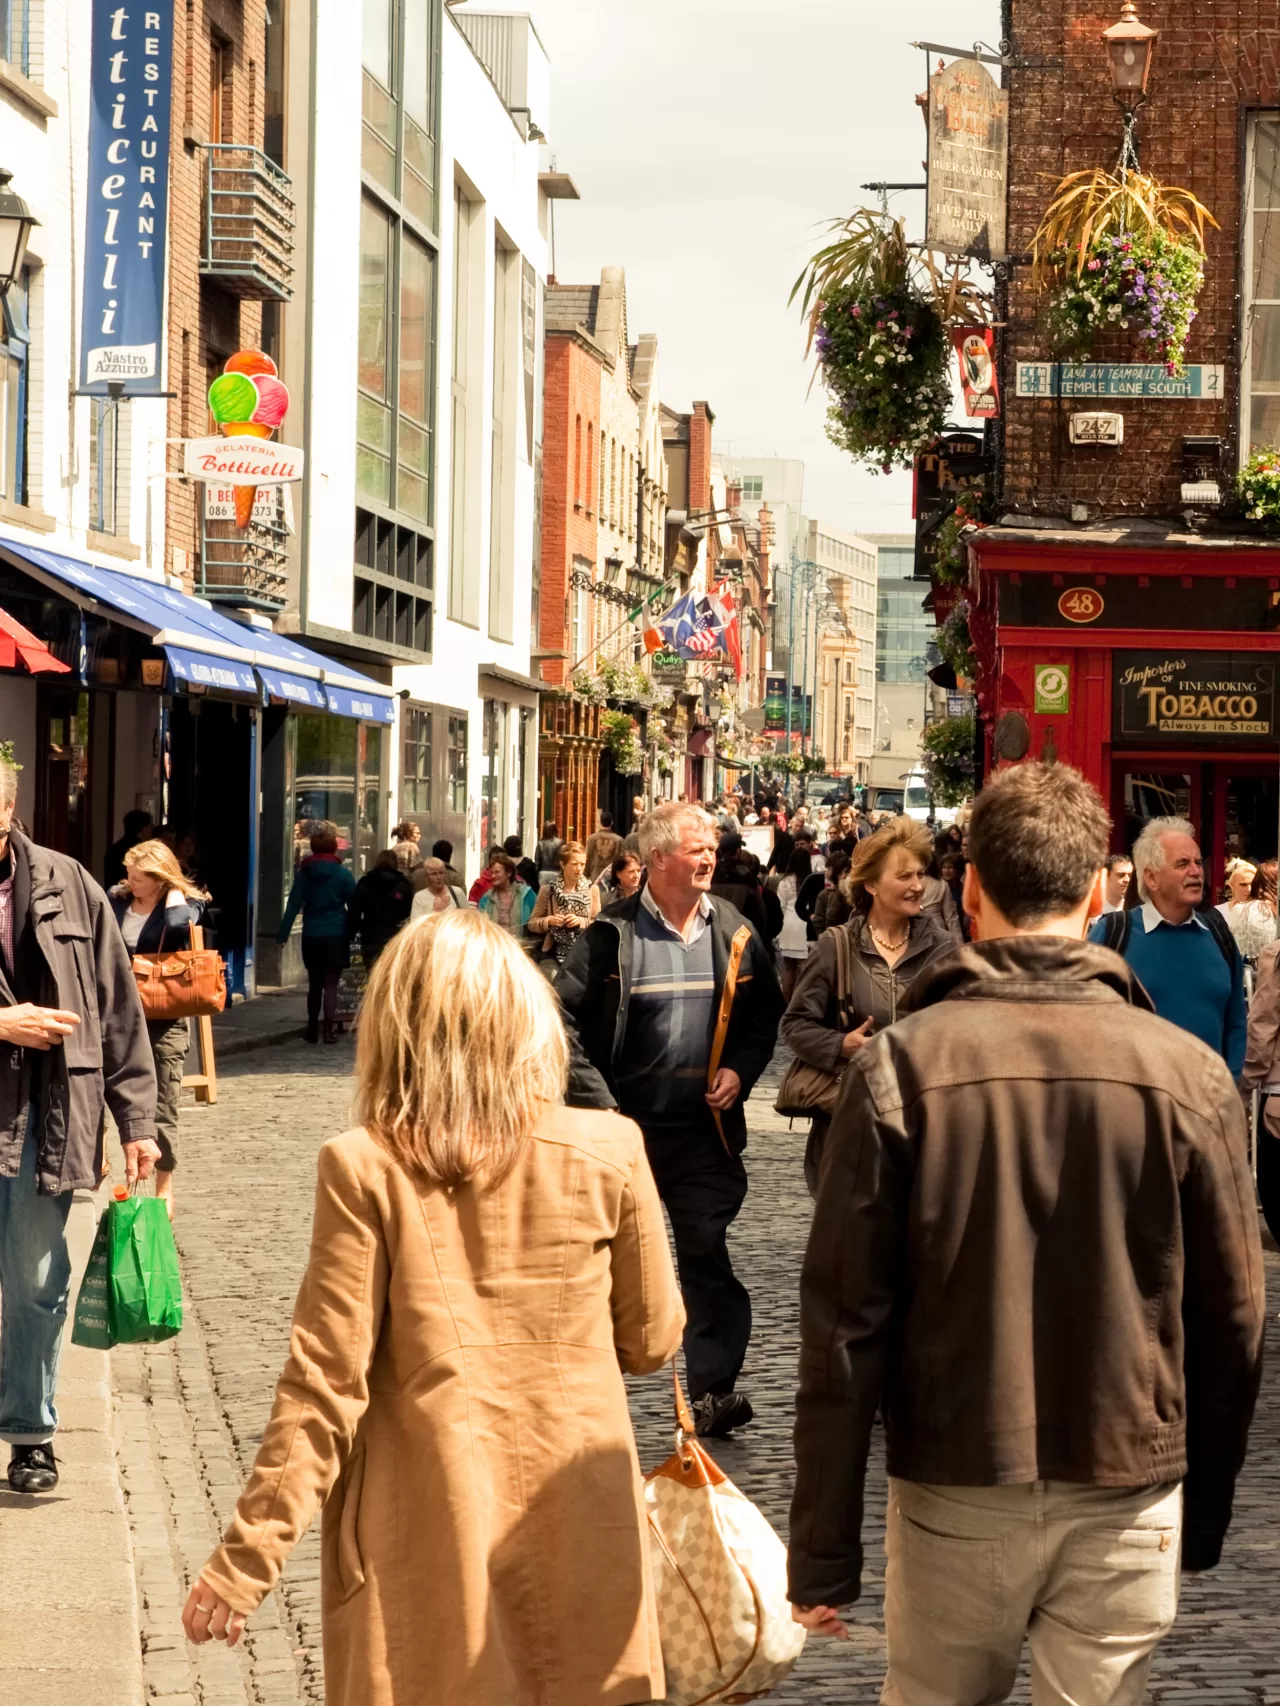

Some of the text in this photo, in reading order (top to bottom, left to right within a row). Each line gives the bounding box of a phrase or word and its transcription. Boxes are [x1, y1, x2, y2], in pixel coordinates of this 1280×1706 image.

[138, 12, 160, 259] RESTAURANT
[101, 7, 130, 334] tticelli
[961, 163, 1003, 180] GARDEN
[936, 203, 961, 217] LIVE
[951, 219, 983, 233] DAILY
[102, 351, 146, 365] Nastro
[95, 361, 148, 374] Azzurro
[1090, 369, 1104, 378] AN
[1060, 382, 1191, 394] TEMPLE LANE SOUTH
[215, 445, 275, 457] GELATERIA
[197, 454, 295, 477] Botticelli
[218, 490, 234, 503] BE
[209, 506, 227, 516] 086
[1066, 592, 1094, 614] 48
[1119, 659, 1187, 686] Importers
[1161, 675, 1174, 684] OF
[1179, 681, 1257, 692] FINE SMOKING
[1137, 686, 1258, 726] TOBACCO
[1161, 720, 1267, 732] Always in Stock
